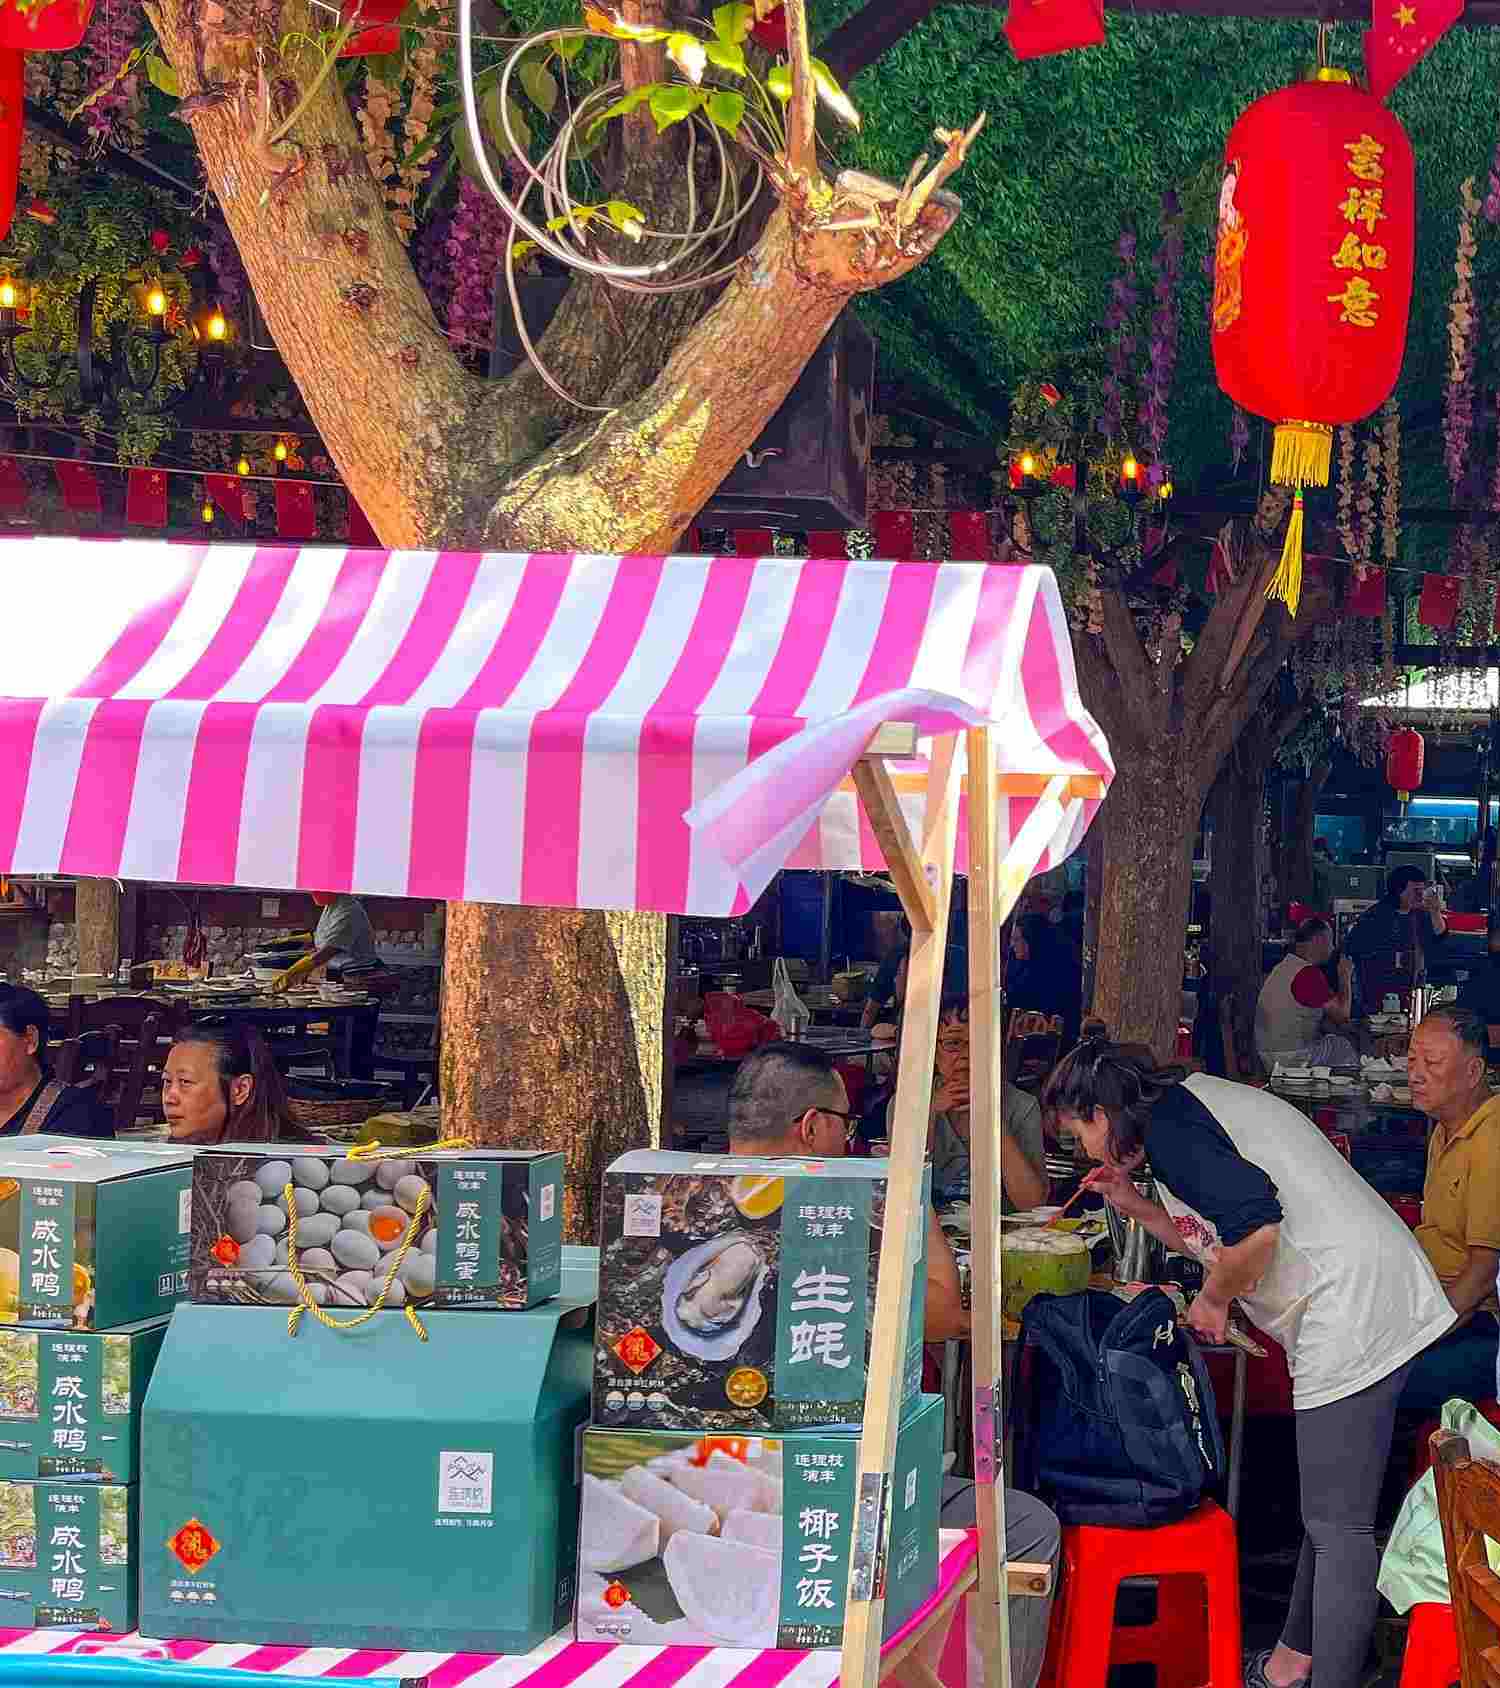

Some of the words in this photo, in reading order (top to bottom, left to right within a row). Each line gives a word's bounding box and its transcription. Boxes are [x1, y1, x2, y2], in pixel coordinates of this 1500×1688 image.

[31, 1219, 63, 1296] 咸水鸭
[454, 1201, 482, 1280] 咸水鸭蛋
[789, 1268, 854, 1368] 生蚝
[51, 1375, 89, 1453] 咸水鸭
[50, 1525, 88, 1601] 咸水鸭
[795, 1506, 841, 1610] 椰子饭
